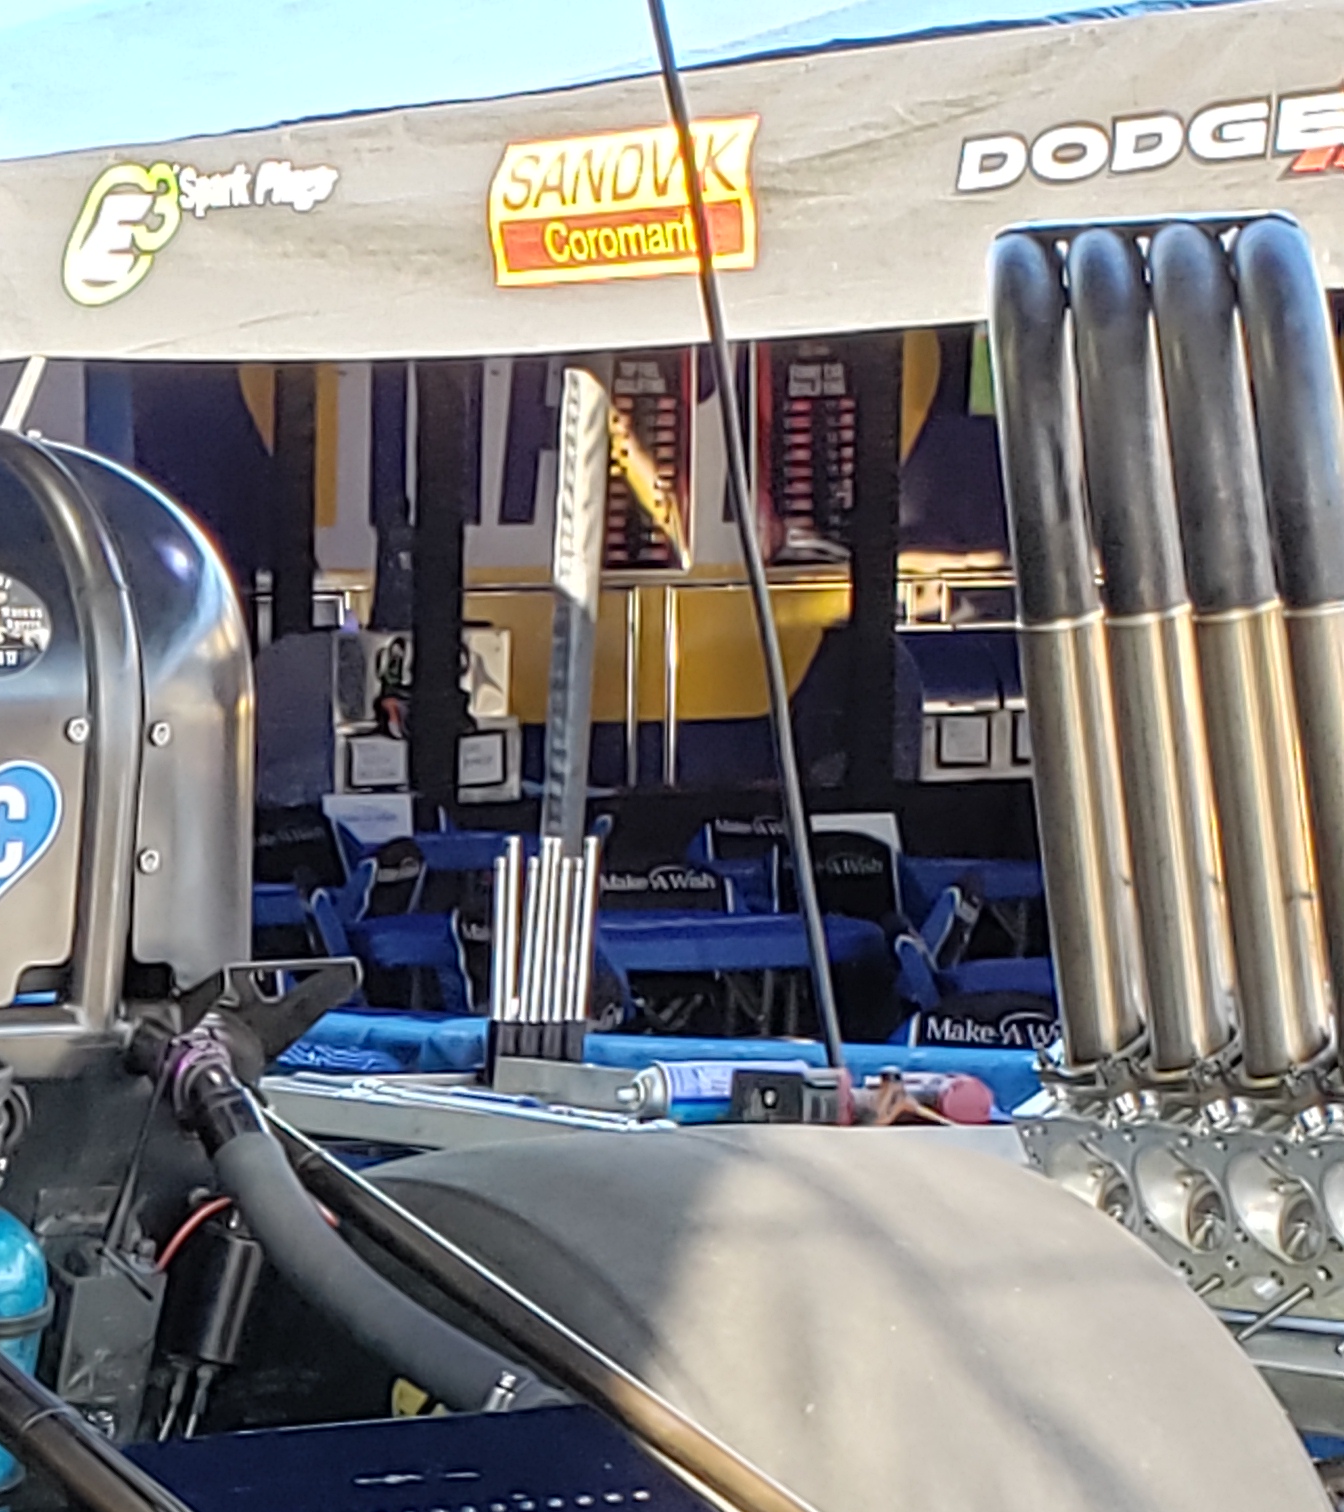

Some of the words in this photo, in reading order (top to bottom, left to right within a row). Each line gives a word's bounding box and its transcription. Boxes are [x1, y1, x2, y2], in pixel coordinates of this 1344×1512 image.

[503, 133, 739, 211] SANDVK
[956, 88, 1344, 193] DODGE
[543, 208, 698, 263] Coromant
